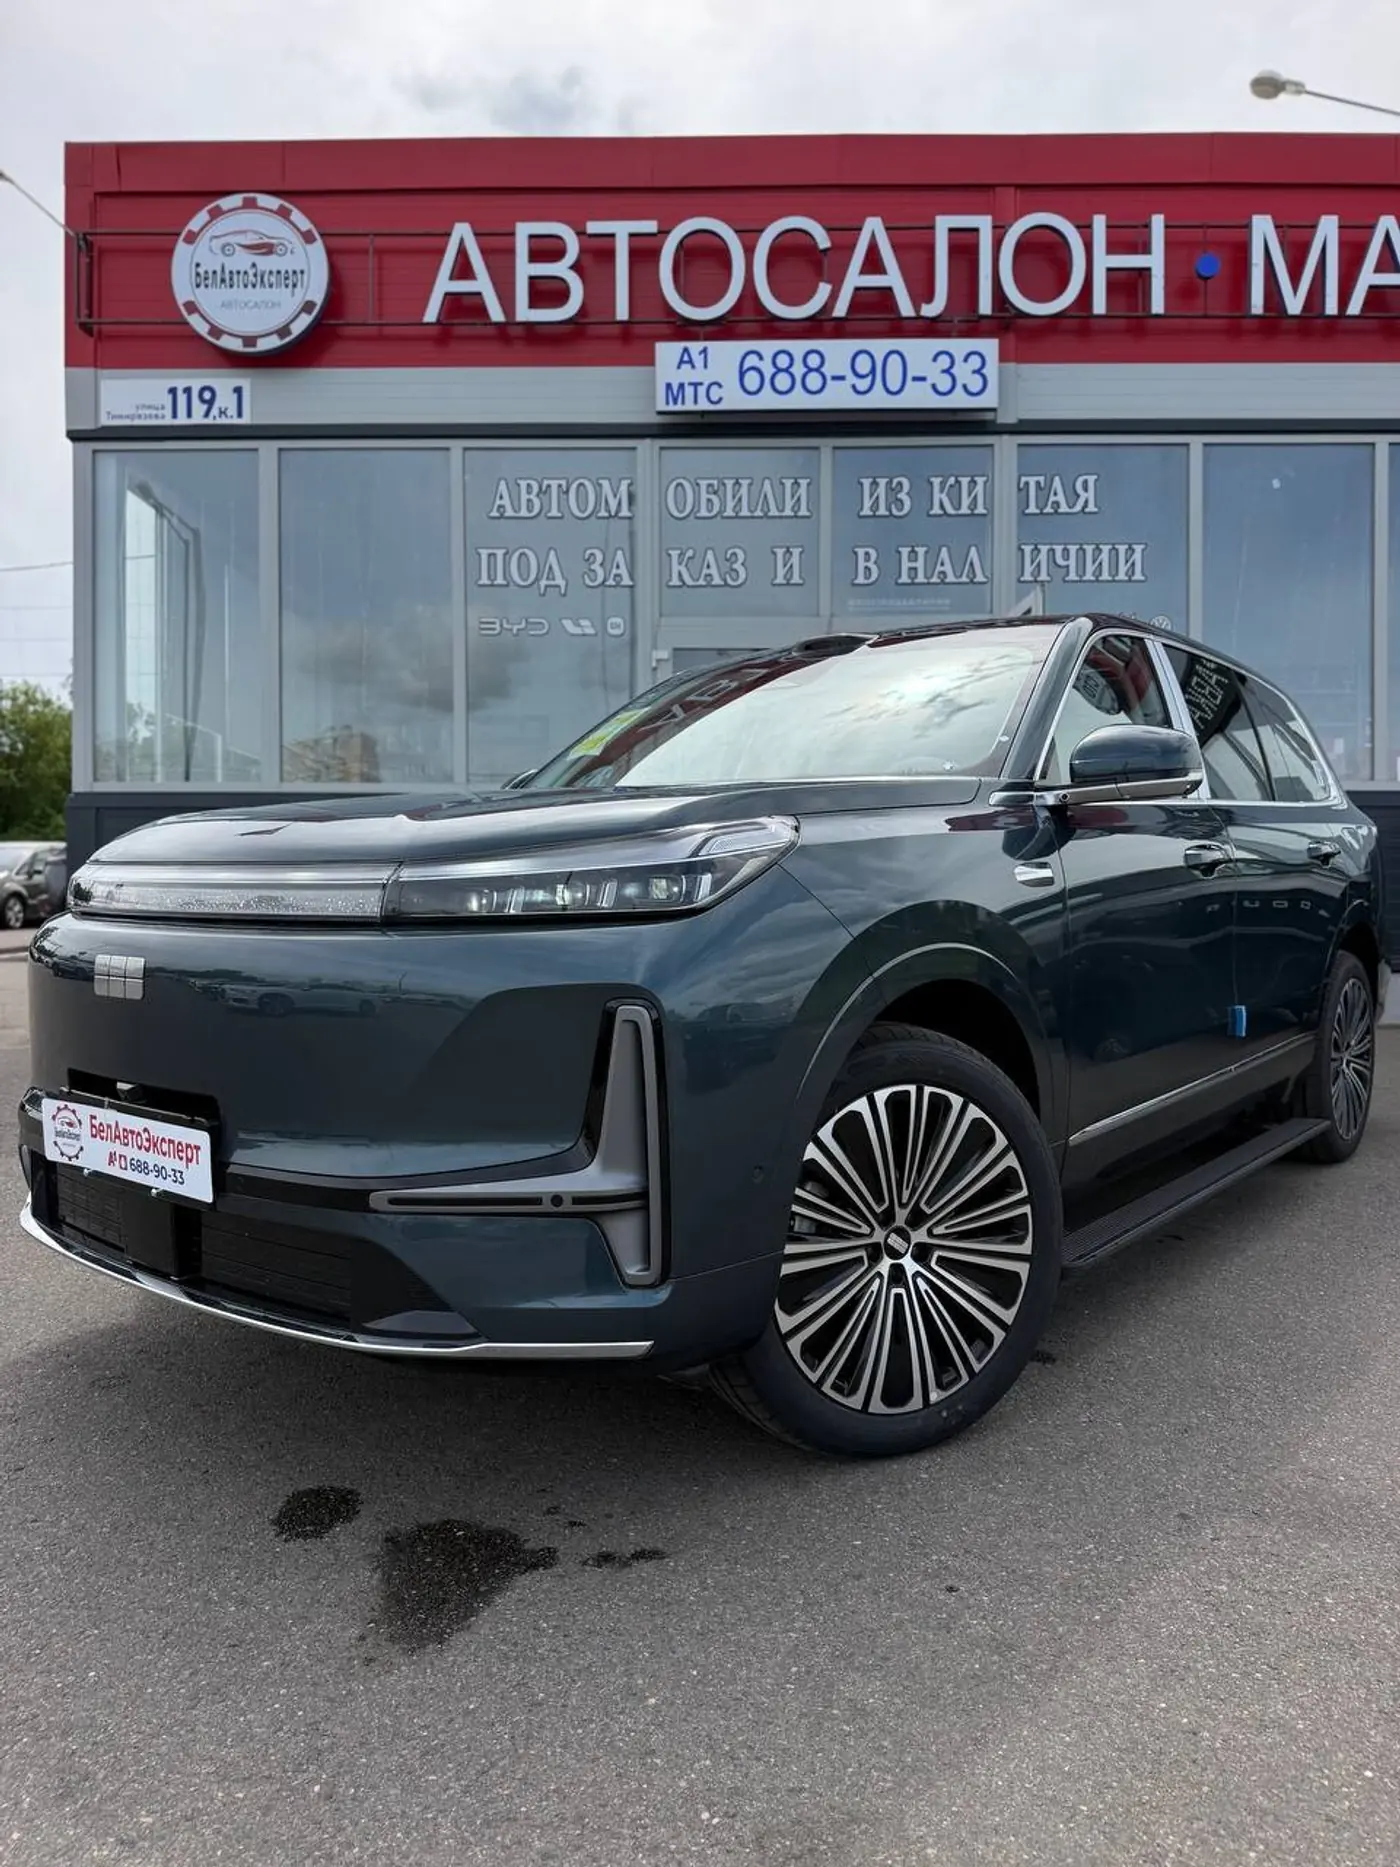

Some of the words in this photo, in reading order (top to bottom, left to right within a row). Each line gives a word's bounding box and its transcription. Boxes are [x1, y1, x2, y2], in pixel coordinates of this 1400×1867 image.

[194, 262, 305, 297] БелАвтоЭксперт
[422, 213, 1165, 322] АВТОСАЛОН
[220, 299, 281, 310] АВТОСАЛОН
[738, 349, 988, 397] 688-90-33
[858, 477, 911, 516] ИЗ
[477, 548, 567, 595] ПОД
[772, 547, 804, 585] И
[852, 547, 879, 585] В
[89, 1114, 201, 1169] БелАвтоЭксперт
[129, 1157, 185, 1185] 688-90-33
